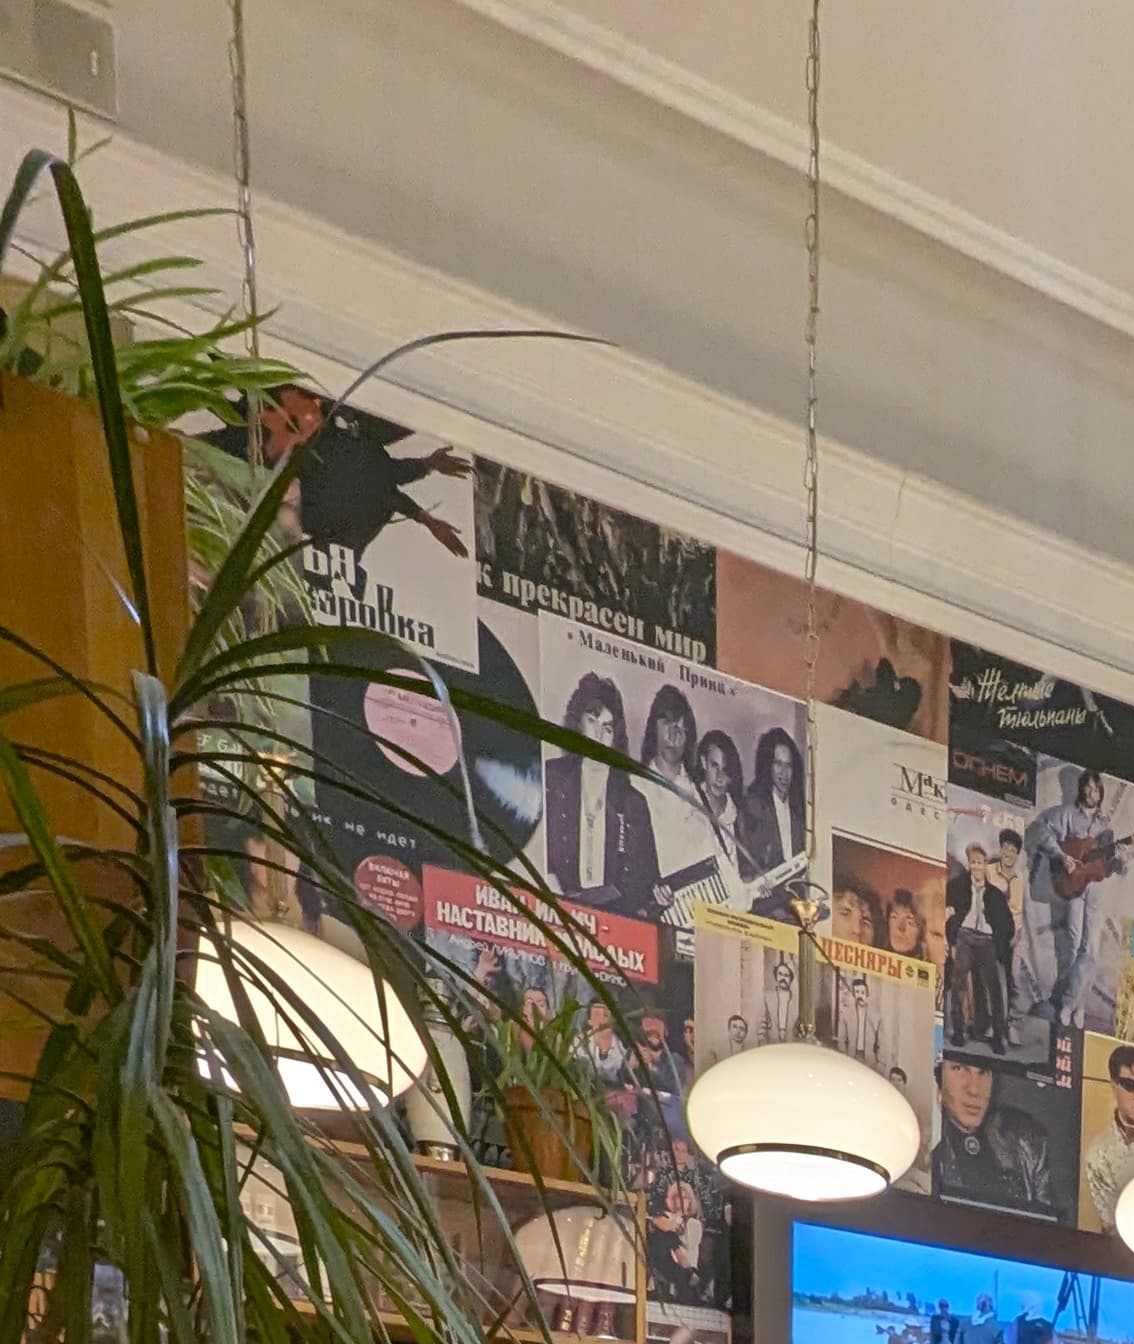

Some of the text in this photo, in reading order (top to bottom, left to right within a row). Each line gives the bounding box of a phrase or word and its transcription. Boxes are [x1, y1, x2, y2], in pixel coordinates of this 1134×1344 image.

[502, 571, 645, 641] прекрасен
[655, 626, 707, 664] мир
[344, 821, 366, 836] не
[376, 831, 417, 849] идет
[436, 900, 547, 948] НАСТАВНИК
[534, 898, 597, 934] ИЛИЧ
[821, 936, 903, 980] ПЕСНЯРЫ
